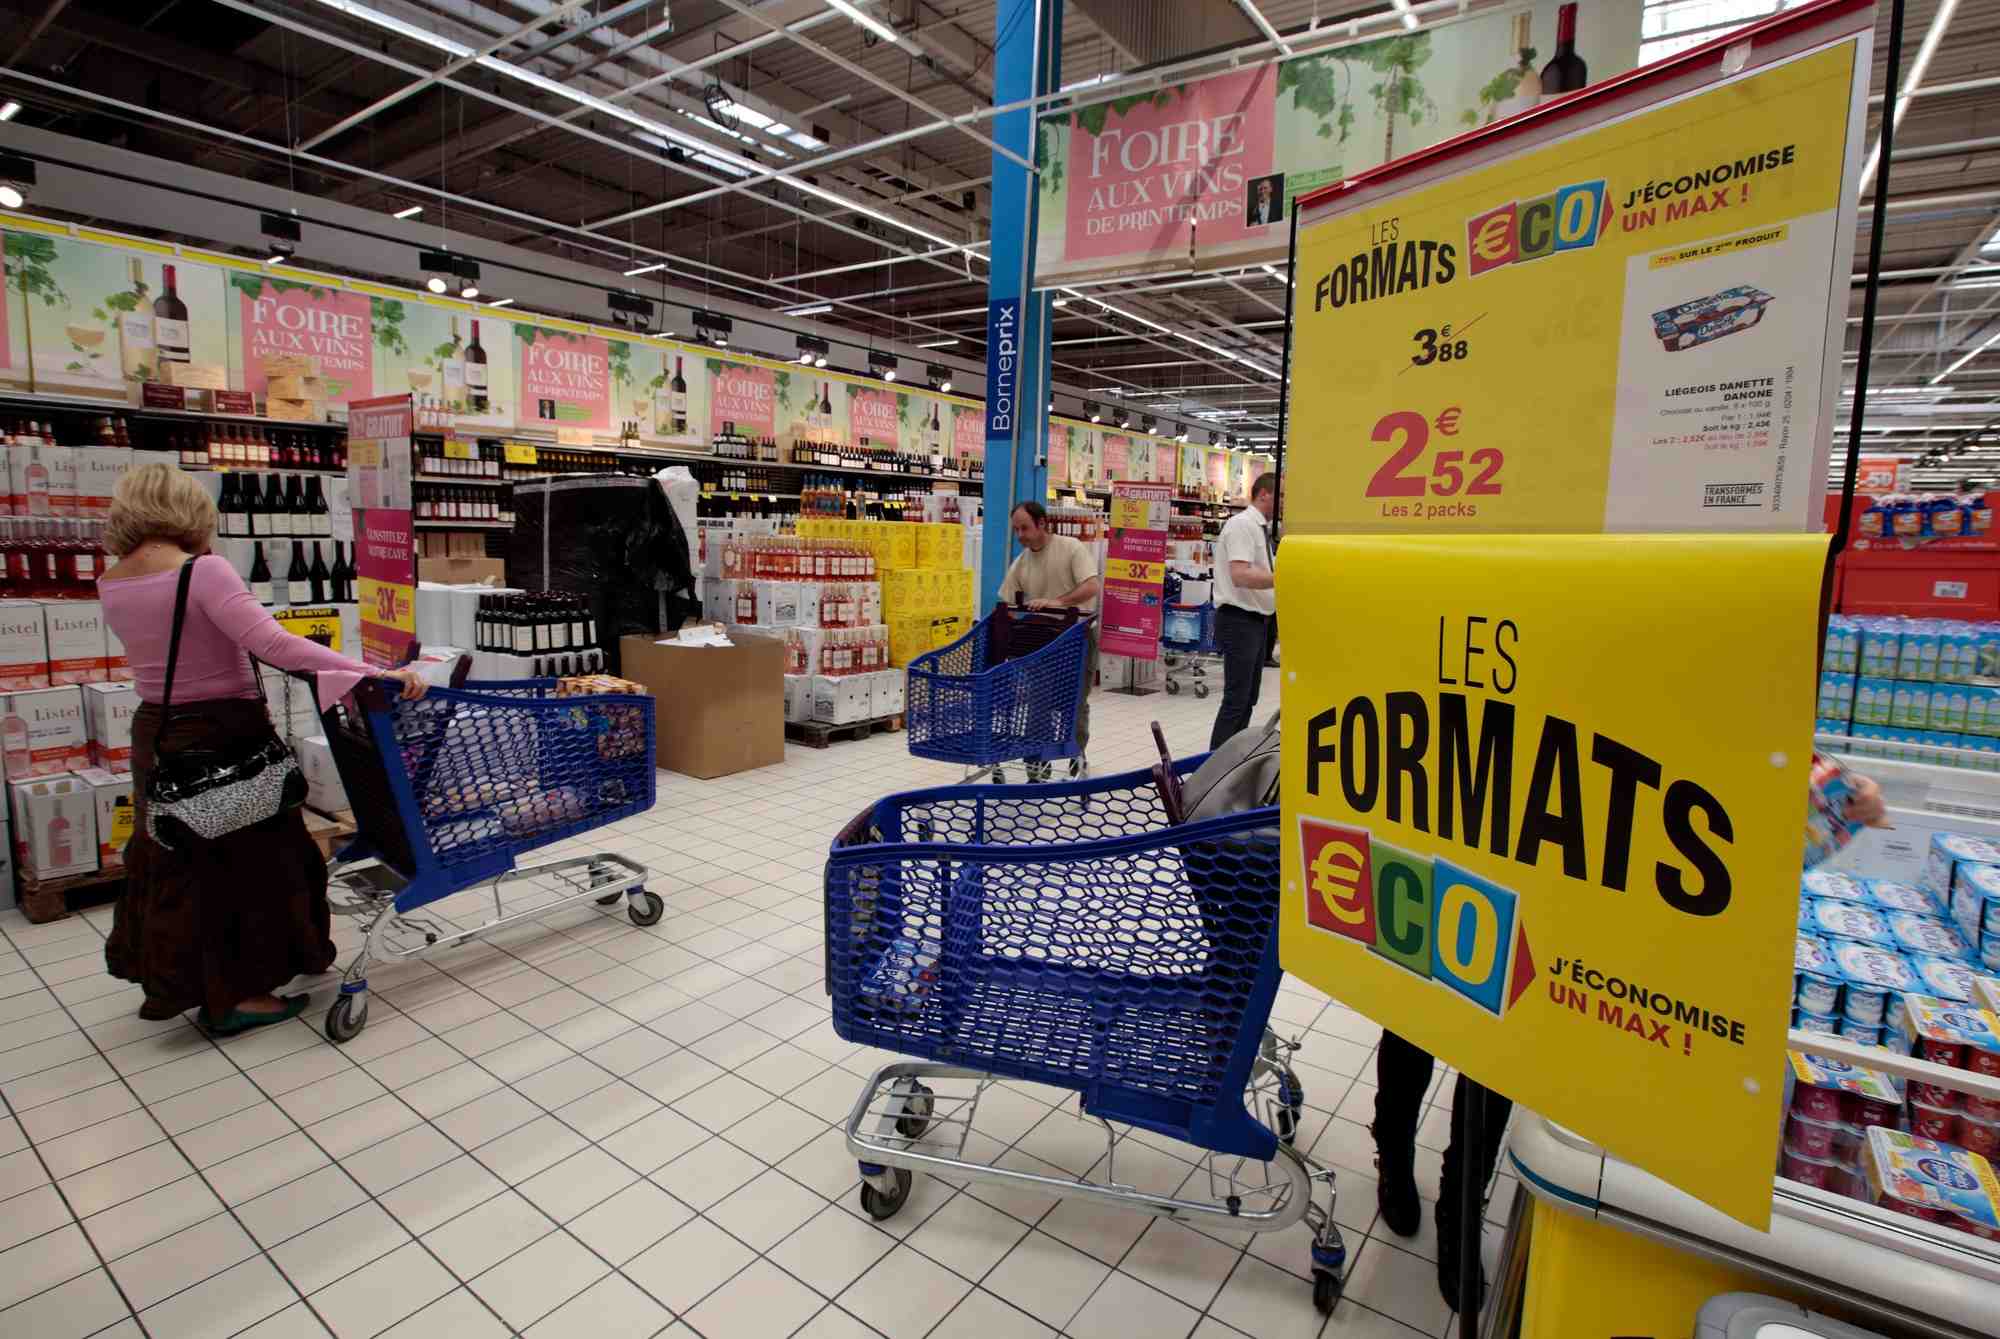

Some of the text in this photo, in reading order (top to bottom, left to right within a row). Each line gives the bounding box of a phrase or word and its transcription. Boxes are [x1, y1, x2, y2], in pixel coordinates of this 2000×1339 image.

[1088, 112, 1246, 178] FOIRE
[1088, 176, 1152, 212] AUX
[1161, 163, 1243, 199] VINS
[1623, 145, 1795, 208] J'ÉCONOMISE
[1088, 198, 1241, 235] DE PRINTEMPS
[1622, 208, 1656, 232] UN
[1666, 187, 1730, 222] MAX
[1370, 217, 1400, 246] LES
[1679, 249, 1698, 259] SUR
[1700, 246, 1713, 255] LE
[1735, 231, 1782, 247] PRODUIT
[1315, 241, 1456, 312] FORMATS
[252, 296, 364, 340] FOIRE
[253, 328, 364, 357] AUX VINS
[528, 342, 604, 374] FOIRE
[528, 368, 604, 389] AUX VINS
[992, 306, 1017, 431] Borneprix
[1719, 377, 1774, 392] DANETTE
[716, 375, 772, 402] FOIRE
[1723, 388, 1774, 401] DANONE
[743, 400, 772, 415] VINS
[1382, 502, 1477, 520] Les 2 packs
[1704, 494, 1747, 505] EN FRANCE
[1128, 562, 1149, 580] 3X
[376, 586, 397, 623] 3X
[0, 618, 97, 635] istel Listel
[1439, 616, 1519, 694] LES
[35, 704, 80, 721] Listel
[1306, 690, 1735, 918] FORMATS
[1549, 957, 1745, 1046] J'ÉCONOMISE
[1549, 981, 1587, 1014] UN
[1598, 999, 1671, 1049] MAX
